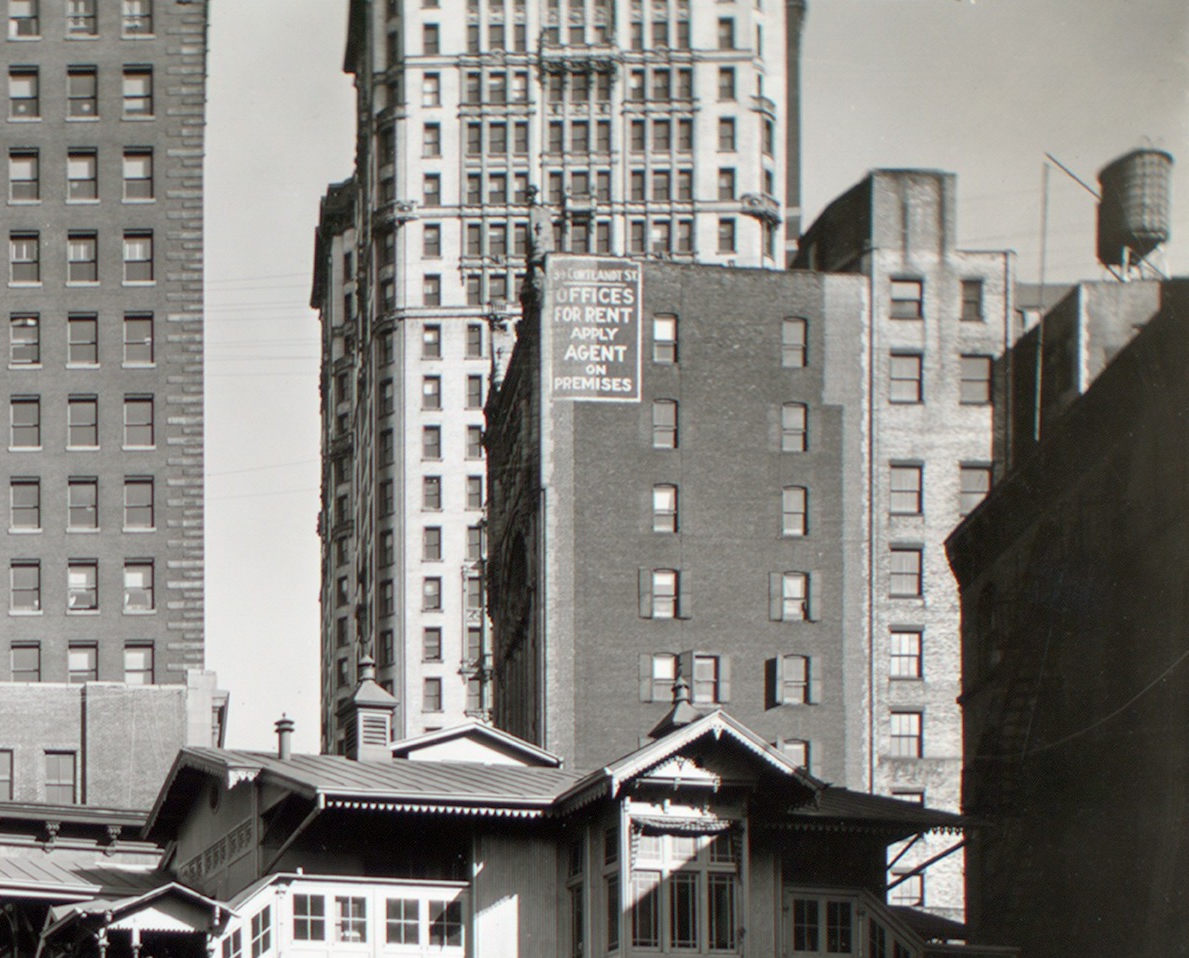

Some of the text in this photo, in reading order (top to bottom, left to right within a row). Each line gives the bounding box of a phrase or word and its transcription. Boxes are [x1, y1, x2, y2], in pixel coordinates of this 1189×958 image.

[556, 287, 634, 304] OFFICES
[554, 306, 633, 323] FOR RENT
[570, 327, 619, 341] APPLY
[564, 344, 627, 362] AGENT
[585, 364, 607, 375] ON
[554, 377, 632, 392] PREMISES
